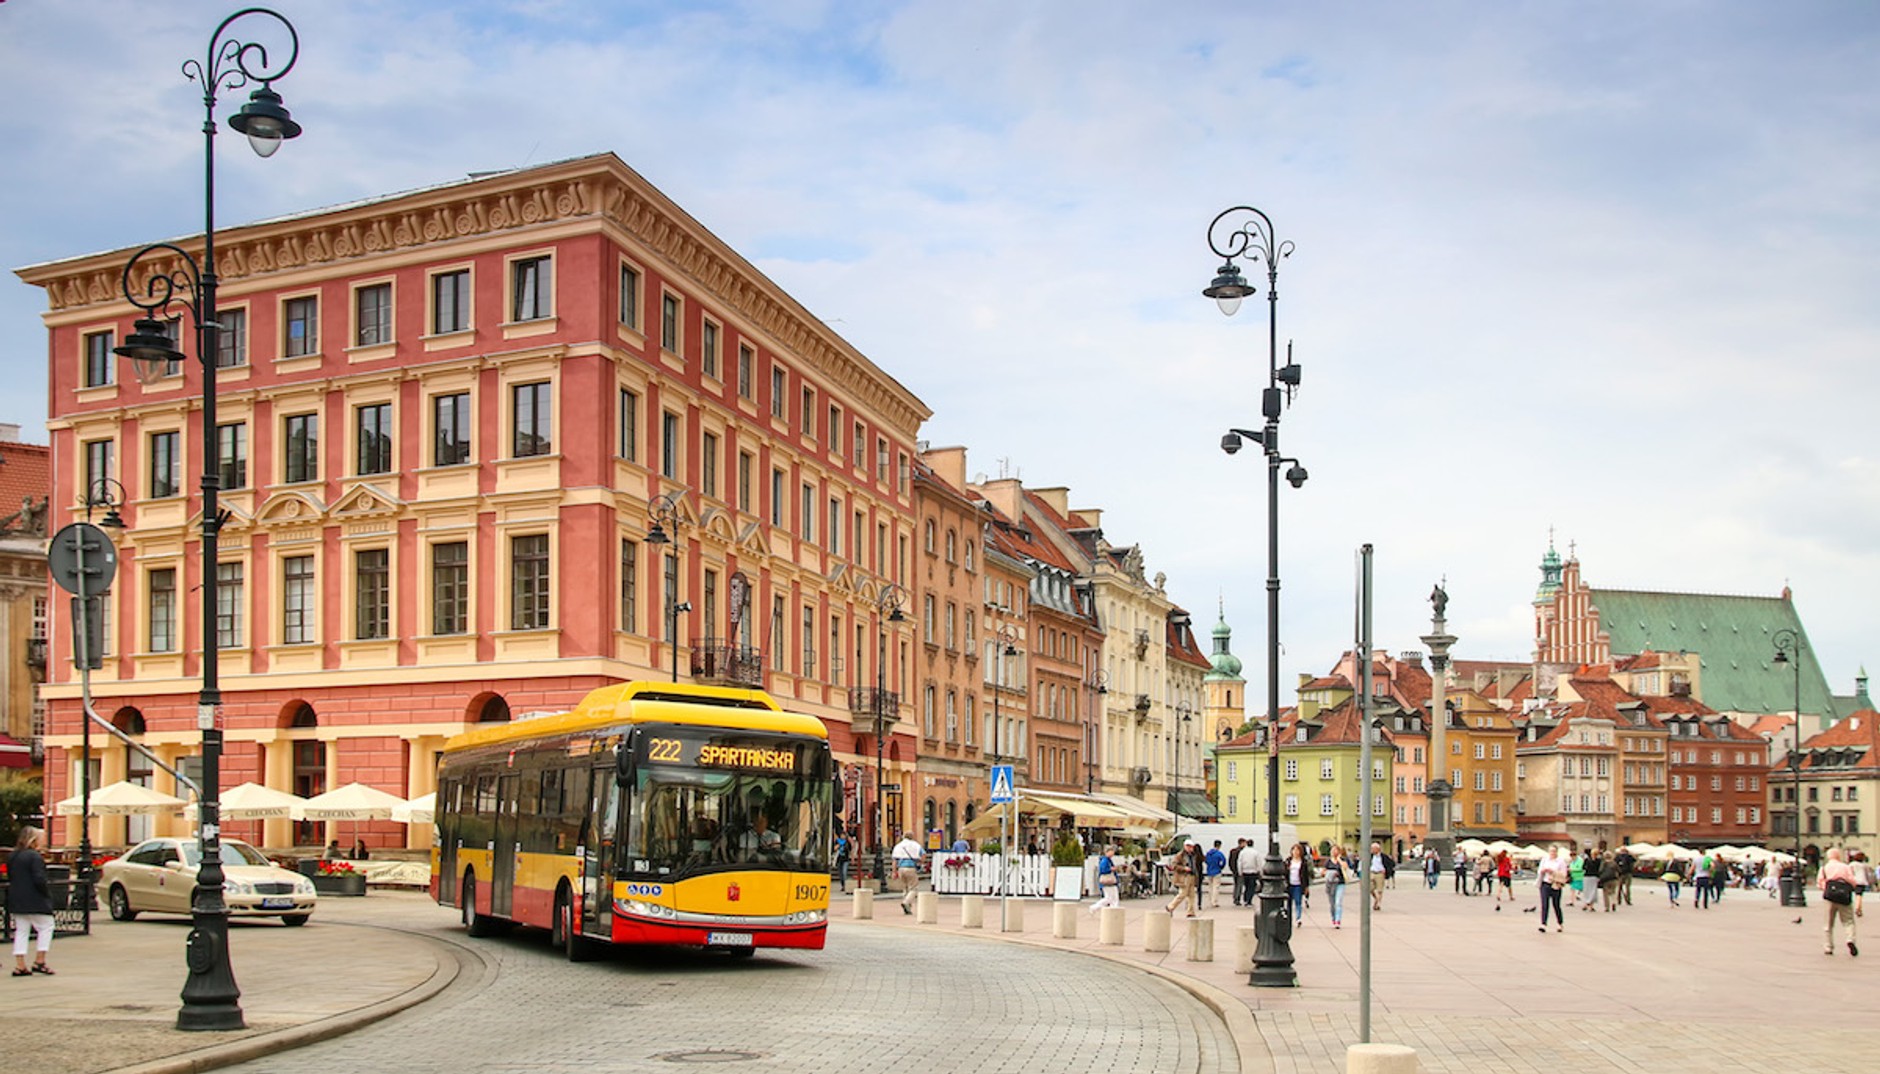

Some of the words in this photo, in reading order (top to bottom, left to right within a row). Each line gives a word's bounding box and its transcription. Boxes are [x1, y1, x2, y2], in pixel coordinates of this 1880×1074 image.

[648, 738, 682, 762] 222
[700, 745, 795, 770] SPARTAŃSKA
[795, 884, 827, 902] 1907
